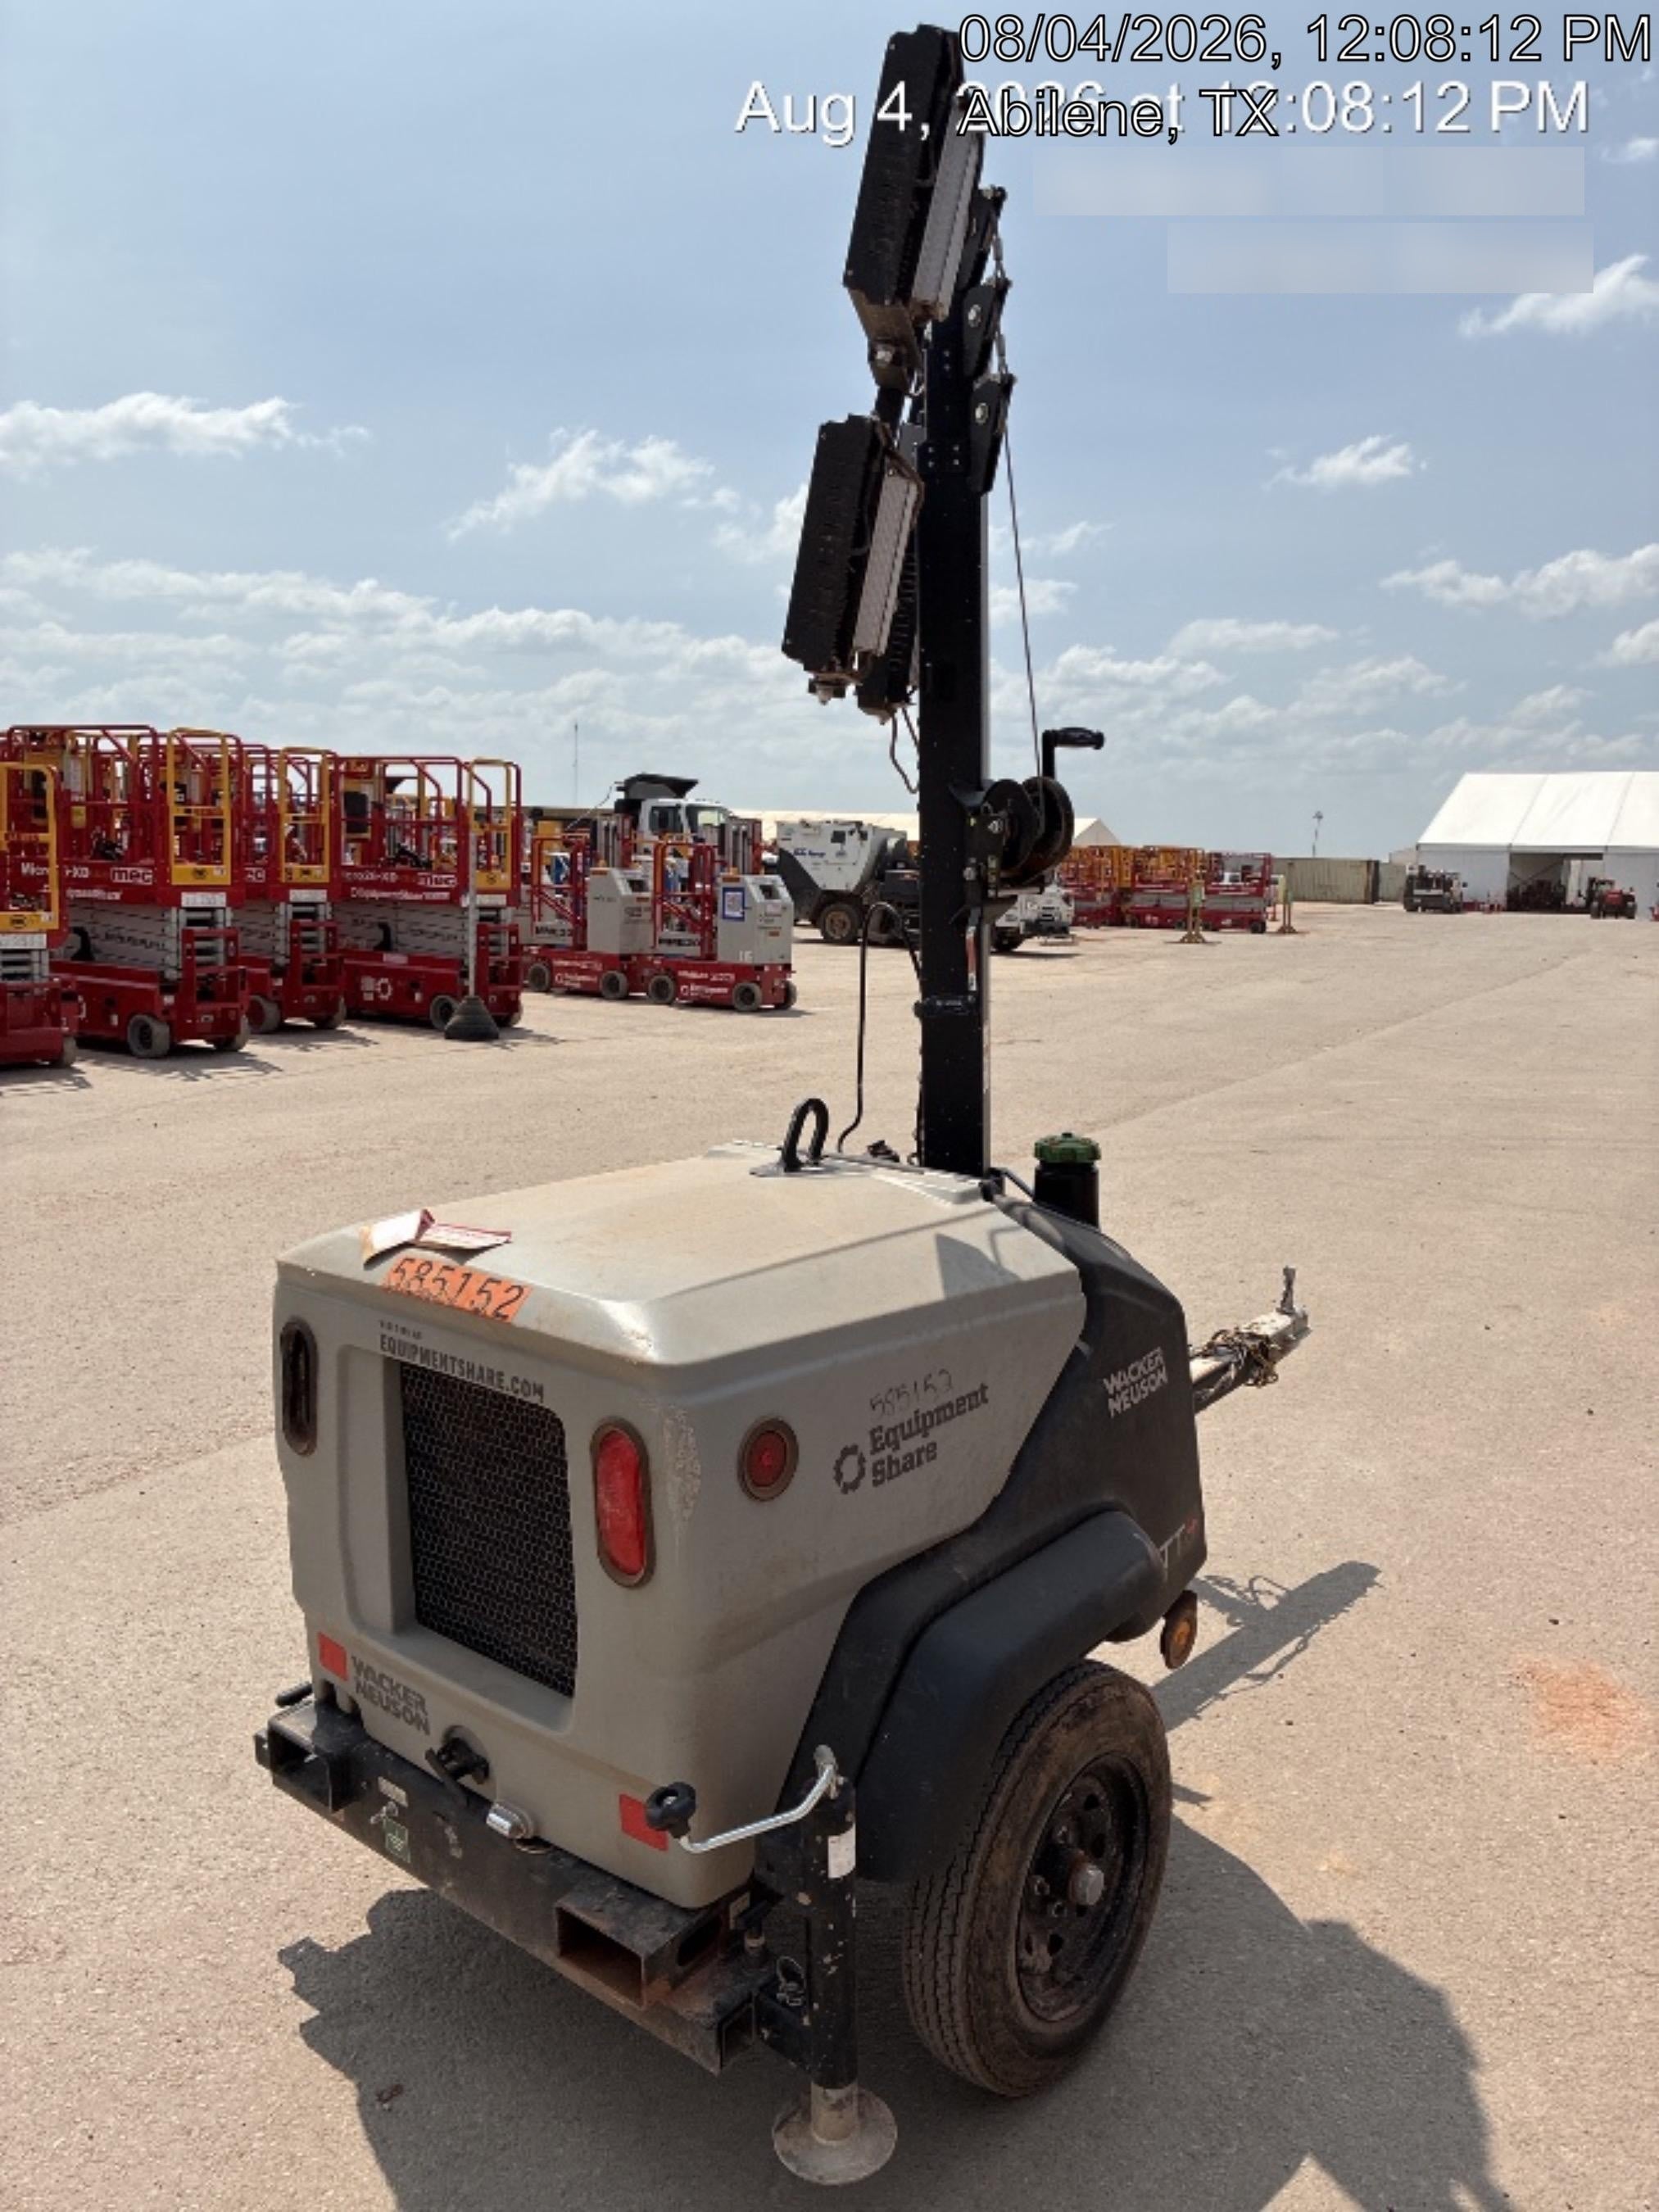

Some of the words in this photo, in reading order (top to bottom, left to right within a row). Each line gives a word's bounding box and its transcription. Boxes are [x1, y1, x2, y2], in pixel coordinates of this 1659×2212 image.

[379, 1334, 545, 1403] EQUIPMENTSHARE.COM
[1102, 1345, 1164, 1395] WACKER
[1107, 1366, 1168, 1419] NEUSON
[868, 1382, 990, 1456] Equipment
[351, 1655, 429, 1716] WACKER
[354, 1678, 431, 1736] NEUSON
